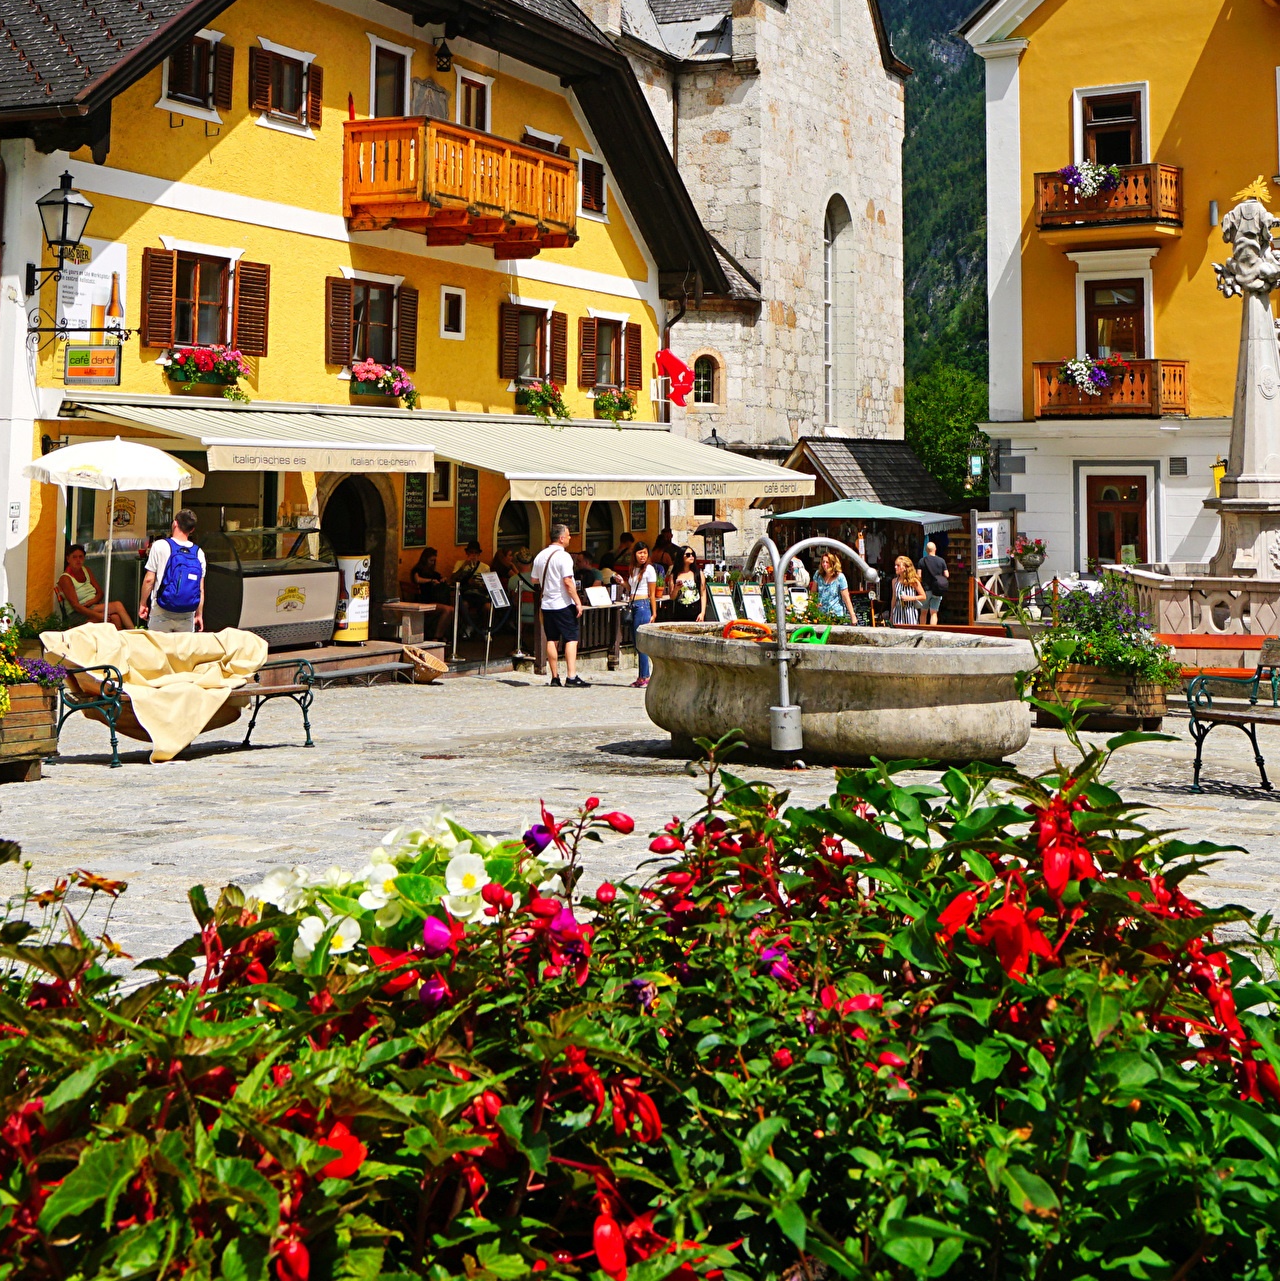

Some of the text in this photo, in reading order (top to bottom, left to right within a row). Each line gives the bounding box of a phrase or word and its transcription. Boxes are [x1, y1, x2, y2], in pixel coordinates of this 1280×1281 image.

[69, 353, 90, 365] café
[232, 453, 307, 466] italienisches eis
[350, 455, 375, 466] italian
[544, 482, 568, 497] café
[645, 483, 727, 496] KONDITOREI RESTAURANT
[764, 482, 779, 494] café
